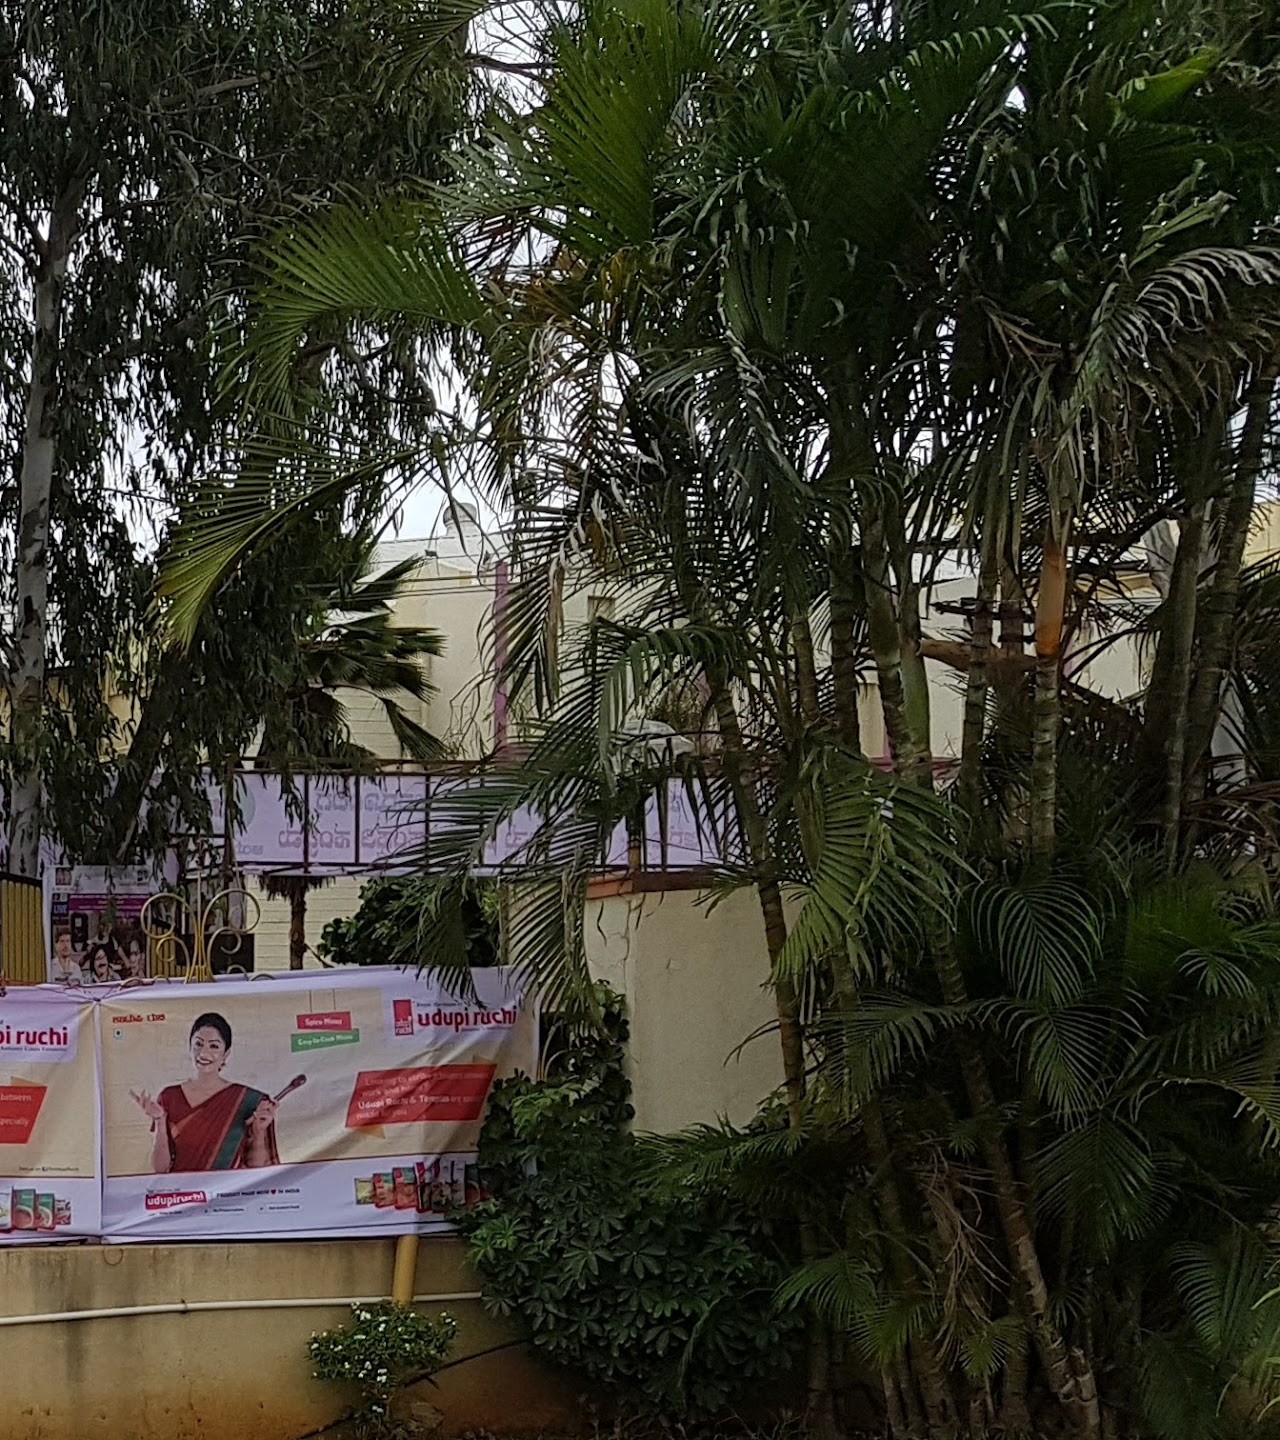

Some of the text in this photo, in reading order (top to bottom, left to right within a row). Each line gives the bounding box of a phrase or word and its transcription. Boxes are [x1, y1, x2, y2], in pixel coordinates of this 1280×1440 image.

[418, 1005, 517, 1033] udupi ruchi
[16, 1026, 68, 1046] ruchi
[358, 1101, 385, 1110] Udupi
